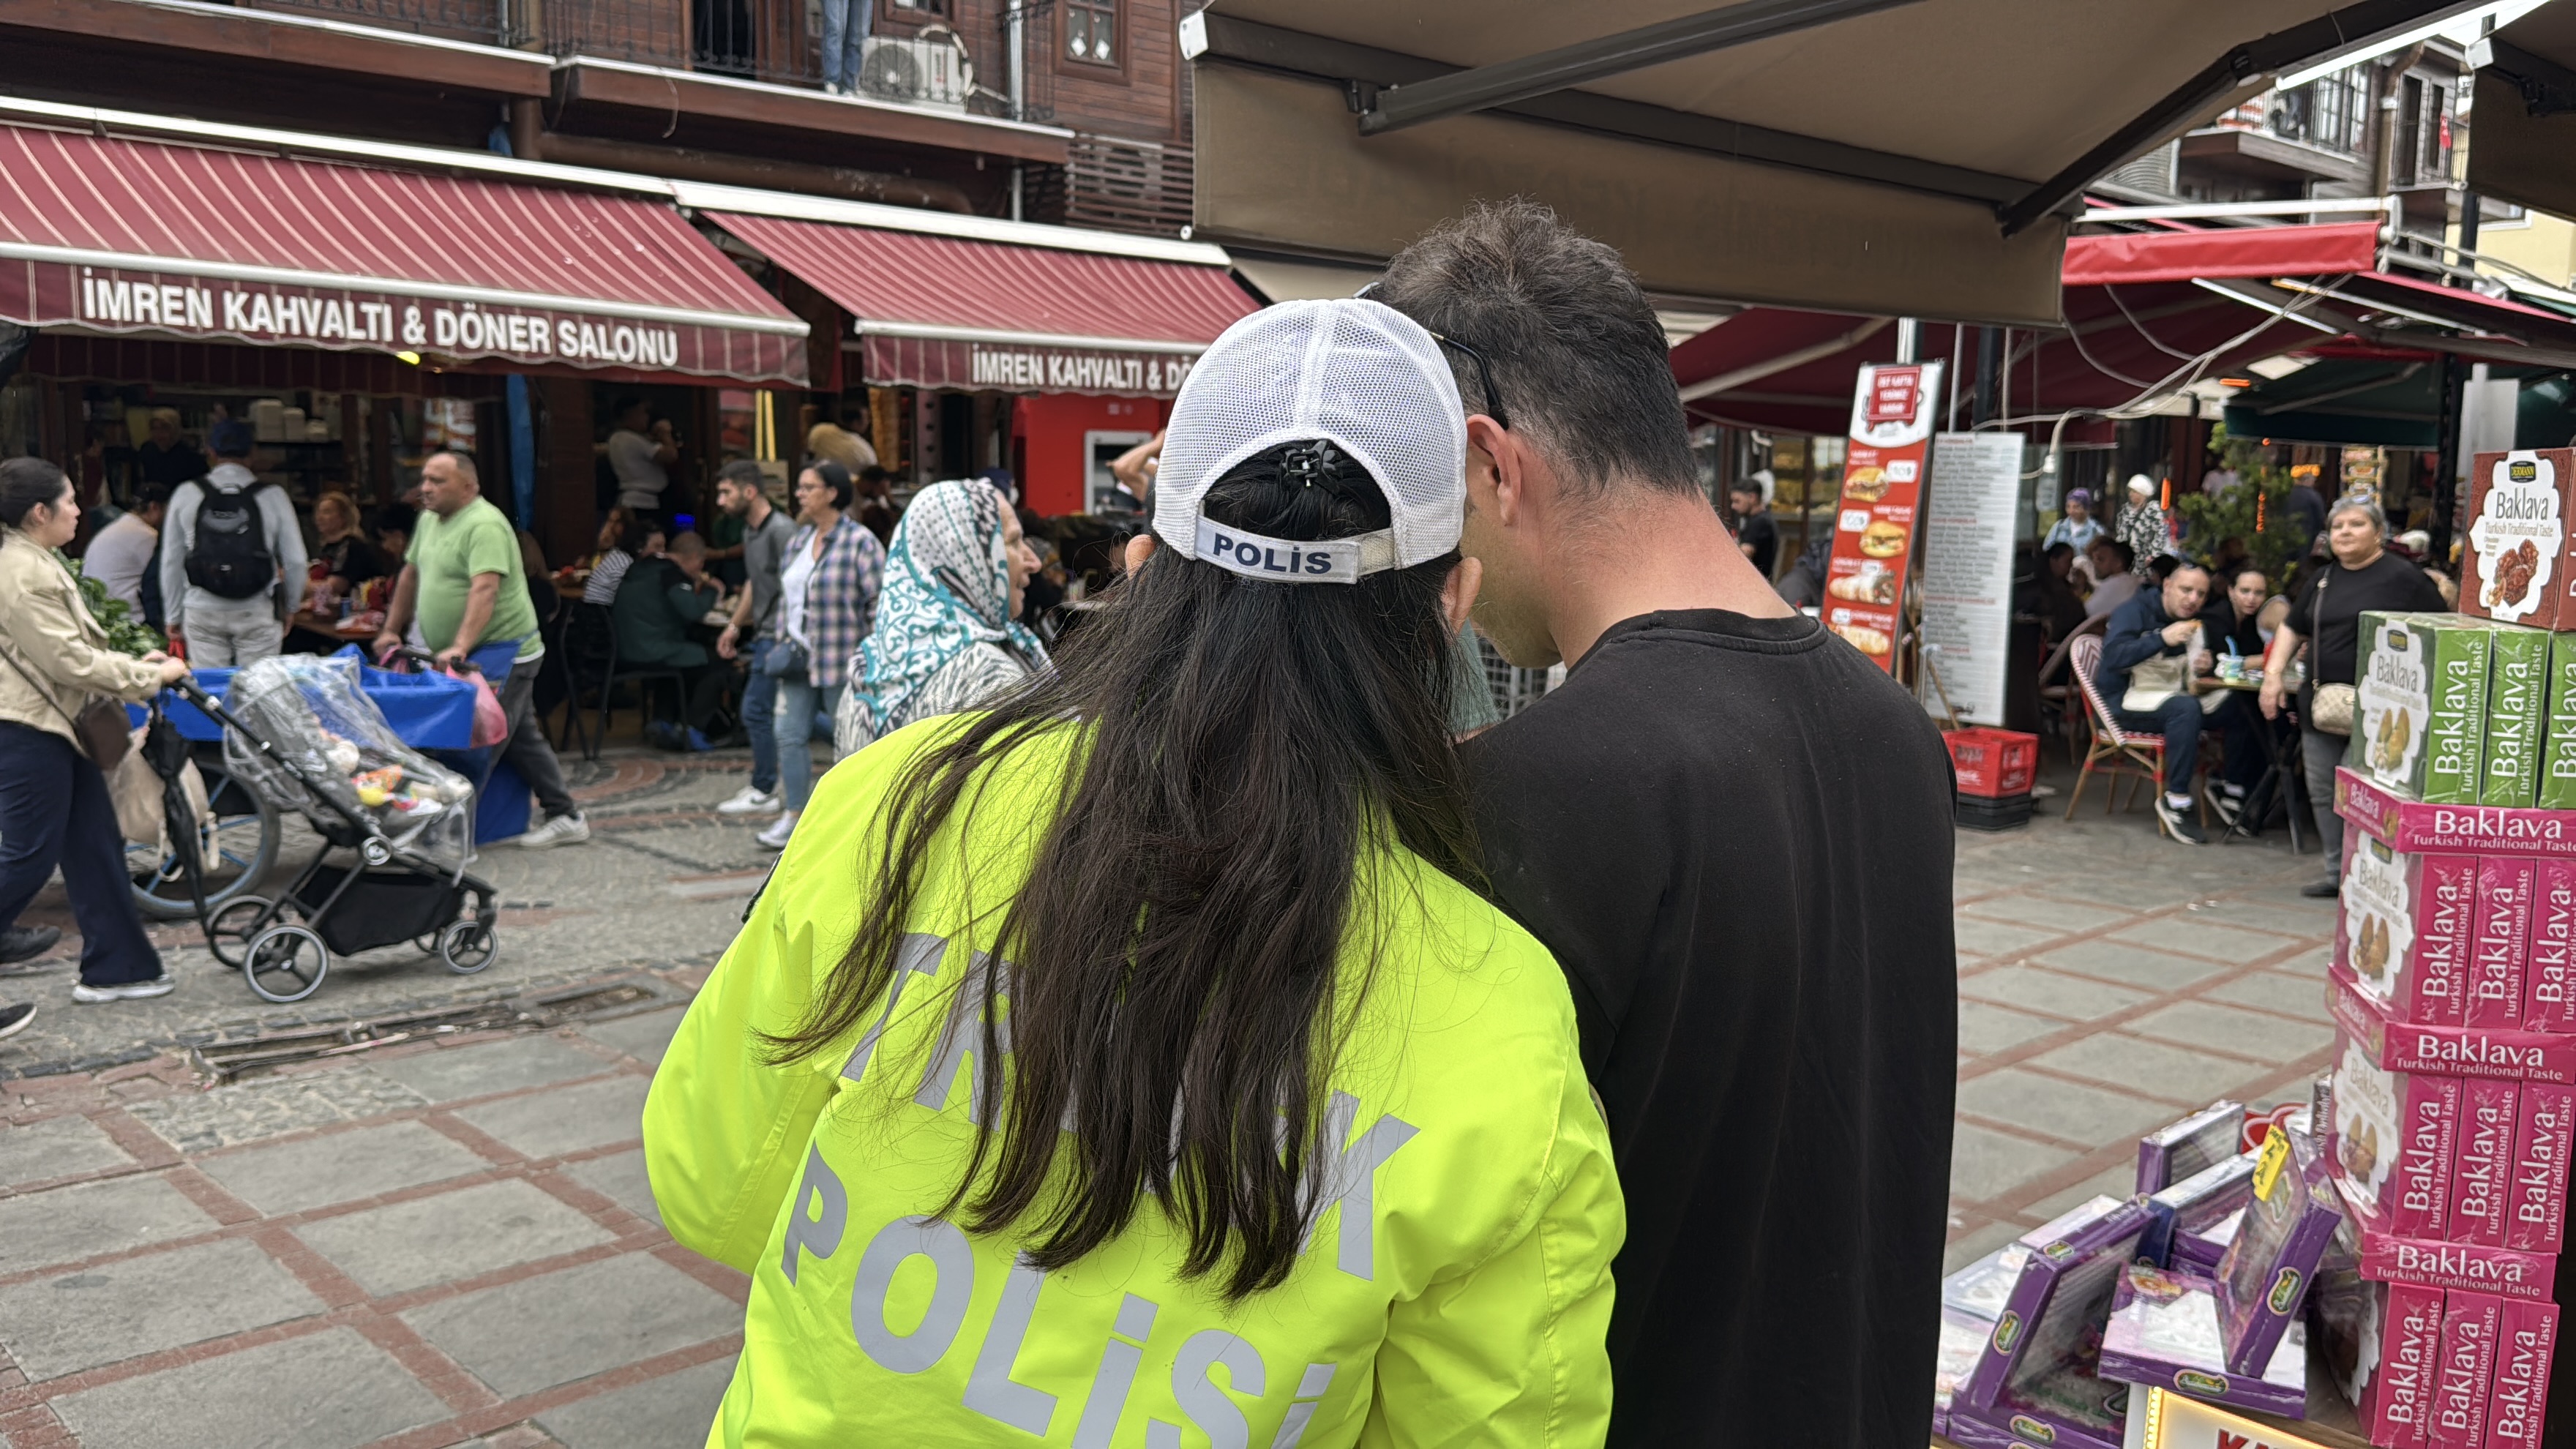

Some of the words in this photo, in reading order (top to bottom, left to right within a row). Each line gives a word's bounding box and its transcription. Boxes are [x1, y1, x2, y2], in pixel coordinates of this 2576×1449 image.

[83, 267, 214, 329] İMREN
[223, 291, 394, 342] KAHVALTI
[402, 306, 427, 345] &
[435, 302, 551, 354] DÖNER
[557, 320, 678, 367] SALONU
[972, 342, 1044, 385] İMREN
[1047, 353, 1142, 389] KAHVALTI
[1146, 360, 1162, 391] &
[2496, 487, 2549, 520] Baklava
[1213, 532, 1332, 574] POLİS
[2376, 654, 2418, 692] Baklava
[2470, 642, 2483, 673] Taste
[2529, 644, 2542, 677] Taste
[2433, 660, 2468, 774] Baklava
[2465, 678, 2481, 744] Traditional
[2490, 662, 2528, 777] Baklava
[2523, 680, 2539, 749] Traditional
[2460, 748, 2475, 793] Turkish
[2517, 751, 2533, 797] Turkish
[2414, 834, 2463, 847] Turkish
[2465, 836, 2541, 850] Traditional
[2545, 839, 2576, 852] Taste
[2434, 808, 2562, 839] Baklava
[2459, 868, 2473, 899] Taste
[2515, 869, 2529, 902] Taste
[2422, 886, 2457, 997] Baklava
[2452, 903, 2469, 968] Traditional
[2478, 888, 2514, 1000] Baklava
[2509, 905, 2526, 970] Traditional
[2536, 889, 2572, 1003] Baklava
[2448, 971, 2463, 1015] Turkish
[2504, 974, 2520, 1018] Turkish
[2397, 1057, 2445, 1071] Turkish
[2449, 1061, 2523, 1078] Traditional
[2526, 1068, 2564, 1081] Taste
[2417, 1034, 2544, 1067] Baklava
[839, 931, 1421, 1281] TRK
[2442, 1085, 2456, 1116] Taste
[2499, 1090, 2514, 1123] Taste
[2557, 1095, 2572, 1128] Taste
[2403, 1101, 2441, 1212] Baklava
[2434, 1119, 2452, 1183] Traditional
[2460, 1107, 2498, 1217] Baklava
[2491, 1125, 2509, 1190] Traditional
[2518, 1112, 2556, 1223] Baklava
[2550, 1130, 2568, 1196] Traditional
[2428, 1186, 2444, 1229] Turkish
[2486, 1191, 2502, 1235] Turkish
[2544, 1198, 2561, 1243] Turkish
[2376, 1265, 2425, 1282] Turkish
[2428, 1273, 2502, 1292] Traditional
[2505, 1282, 2541, 1297] Taste
[2397, 1245, 2523, 1282] Baklava
[2425, 1300, 2440, 1332] Taste
[2481, 1306, 2496, 1338] Taste
[2537, 1315, 2553, 1347] Taste
[2386, 1316, 2425, 1423] Baklava
[2418, 1334, 2436, 1397] Traditional
[2441, 1322, 2480, 1429] Baklava
[2473, 1341, 2491, 1404] Traditional
[2497, 1330, 2536, 1439] Baklava
[2528, 1349, 2548, 1413] Traditional
[2411, 1399, 2427, 1442] Turkish
[2465, 1406, 2483, 1449] Turkish
[2524, 1415, 2539, 1449] urkish
